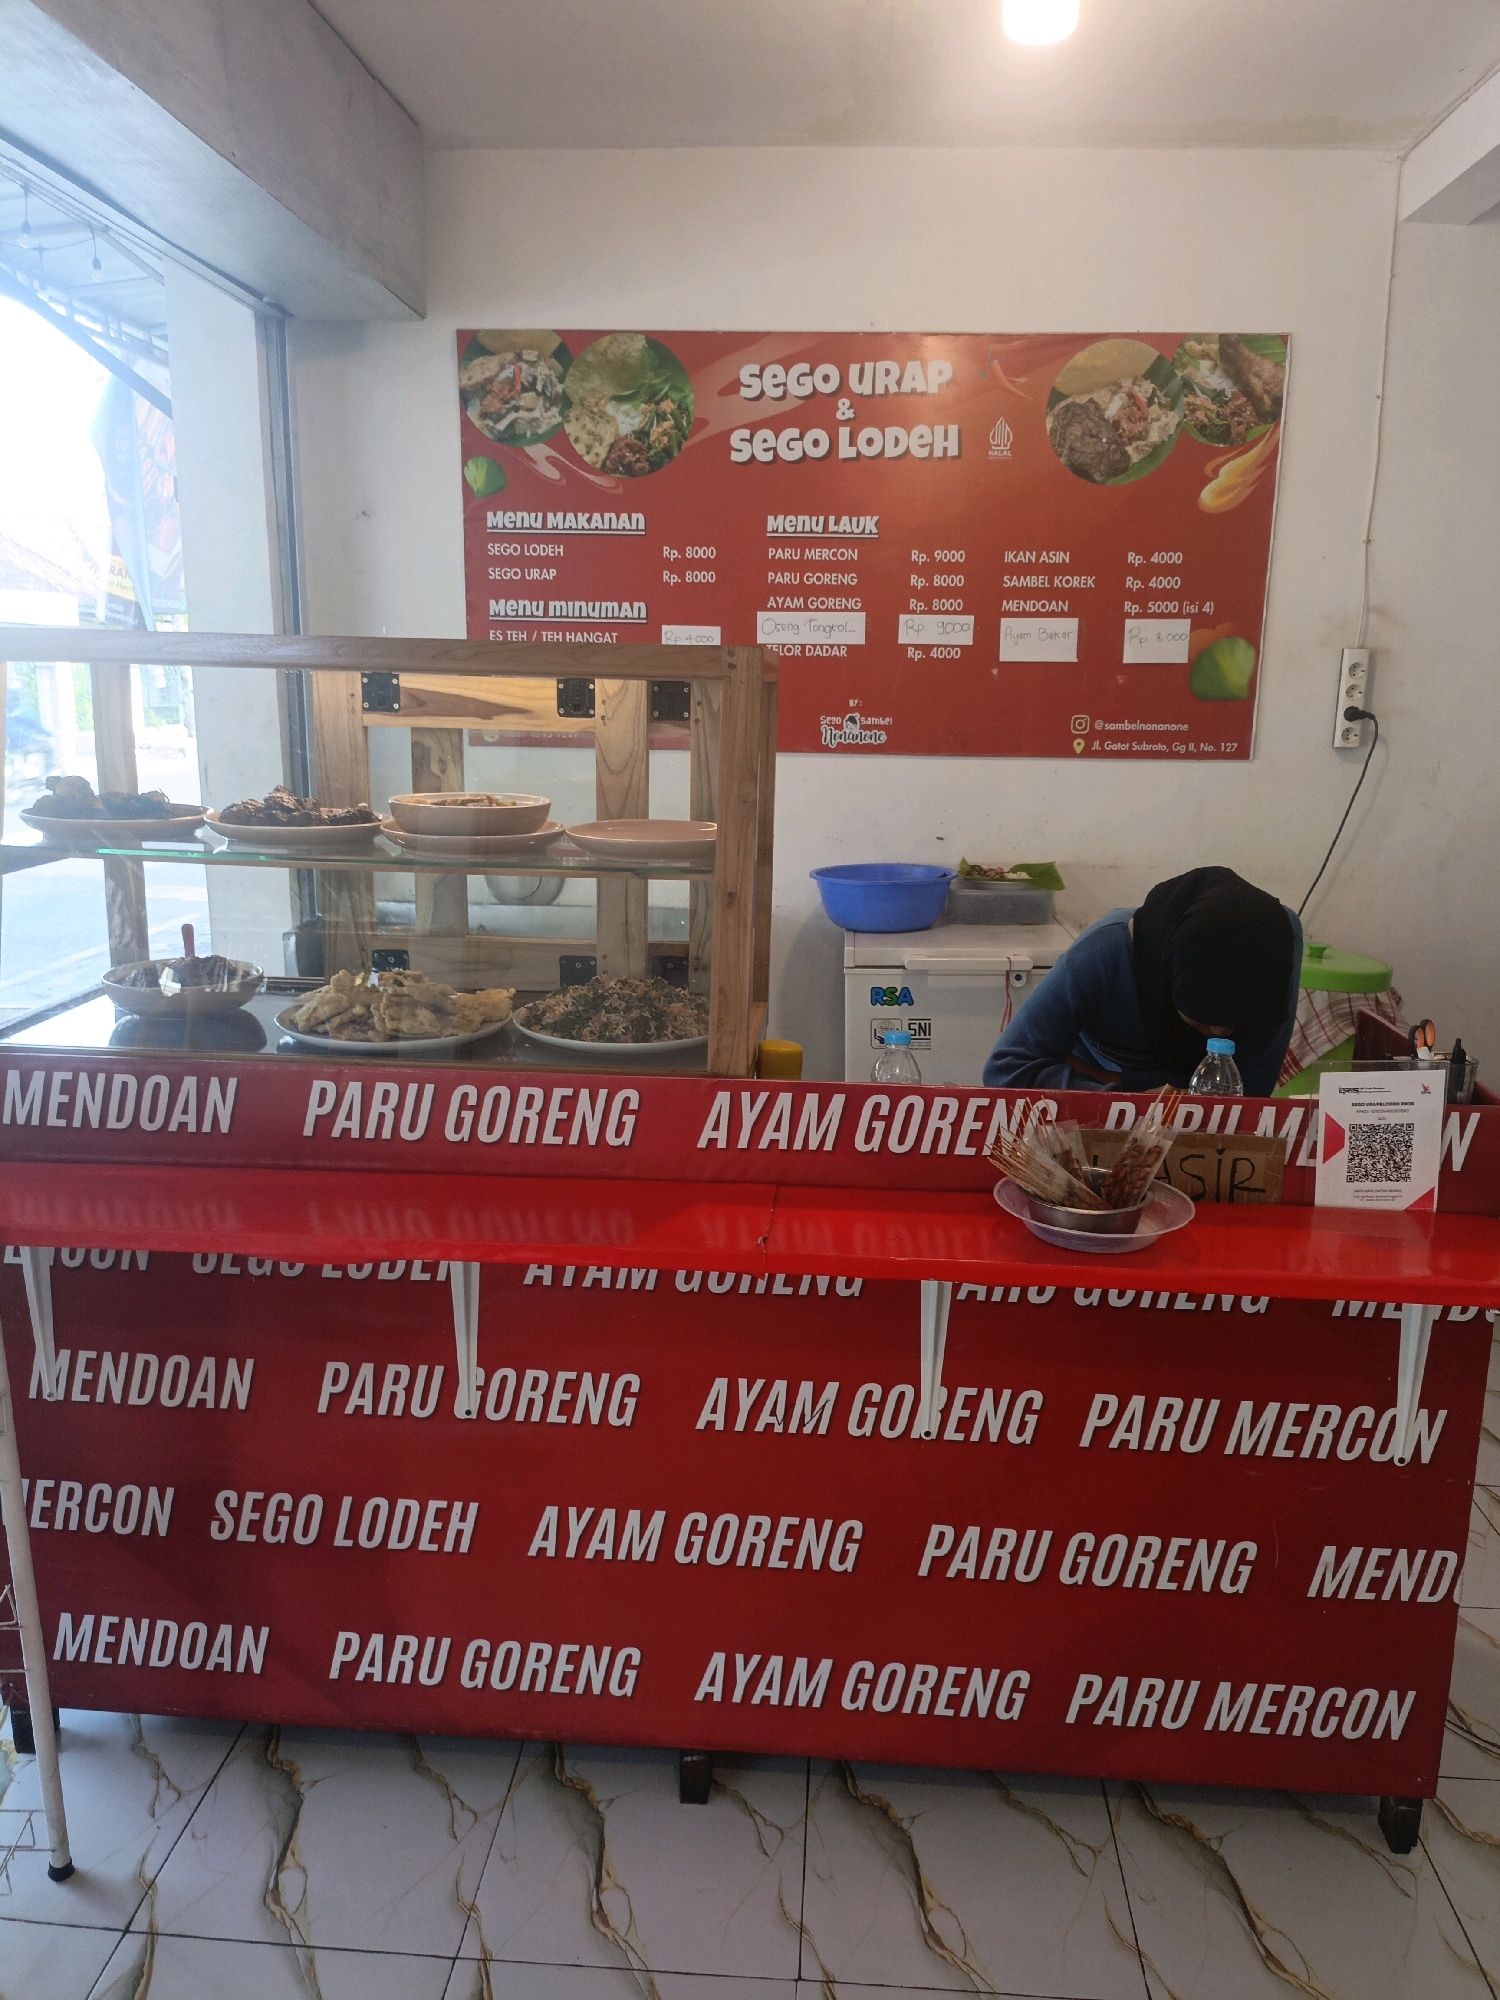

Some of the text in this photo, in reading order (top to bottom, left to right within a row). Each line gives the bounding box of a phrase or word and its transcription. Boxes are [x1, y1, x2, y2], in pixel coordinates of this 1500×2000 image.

[836, 398, 855, 420] &
[829, 516, 879, 534] LAUK
[487, 543, 716, 561] SEGO LODEH Rp. 8000
[768, 548, 966, 565] PARU MERCON Rp. 9000
[1004, 551, 1183, 567] IKAN ASIN Rp. 4000
[488, 568, 716, 585] SEGO URAP Rp. 8000
[767, 572, 965, 589] PARU GORENG Rp. 8000
[1003, 576, 1181, 591] SAMBEL KOREK Rp. 4000
[767, 597, 964, 613] AYAM GORENG Rp. 8000
[1001, 600, 1215, 616] MENDOAN Rp. 5000 (isi 4)
[489, 630, 503, 641] ES
[506, 631, 527, 641] TEH
[541, 631, 562, 642] TEH
[566, 632, 618, 643] HANGAT
[904, 619, 924, 637] Rp
[937, 621, 971, 635] 9000
[1005, 627, 1031, 645] Ayam
[1038, 627, 1073, 641] Bakar
[1128, 627, 1148, 649] Rp
[805, 645, 847, 657] DADAR
[907, 647, 926, 661] Rp.
[930, 647, 961, 659] 4000
[1094, 719, 1189, 732] @sambelnonanone
[1104, 741, 1129, 751] Gatot
[1132, 741, 1169, 753] Subroto,
[1172, 742, 1186, 753] Gg
[1200, 743, 1216, 752] No.
[1220, 743, 1237, 752] 127
[871, 987, 914, 1006] RSA
[908, 1022, 931, 1036] SNI
[3, 1069, 238, 1135] MENDOAN
[303, 1080, 435, 1142] PARU
[444, 1085, 640, 1148] GORENG
[698, 1091, 846, 1152] AYAM
[855, 1094, 1058, 1158] GORENG
[29, 1349, 254, 1411] MENDOAN
[317, 1361, 444, 1418] PARU
[696, 1377, 840, 1435] AYAM
[1079, 1393, 1220, 1453] PARU
[1224, 1401, 1448, 1464] MERCON
[210, 1490, 323, 1545] SEGO
[333, 1496, 479, 1553] LODEH
[528, 1506, 666, 1562] AYAM
[675, 1512, 864, 1573] GORENG
[917, 1524, 1053, 1583] PARU
[1059, 1532, 1258, 1593] GORENG
[53, 1612, 1416, 1741] MENDOAN PARU GORENG AYAM GORENG PARU MERCON
